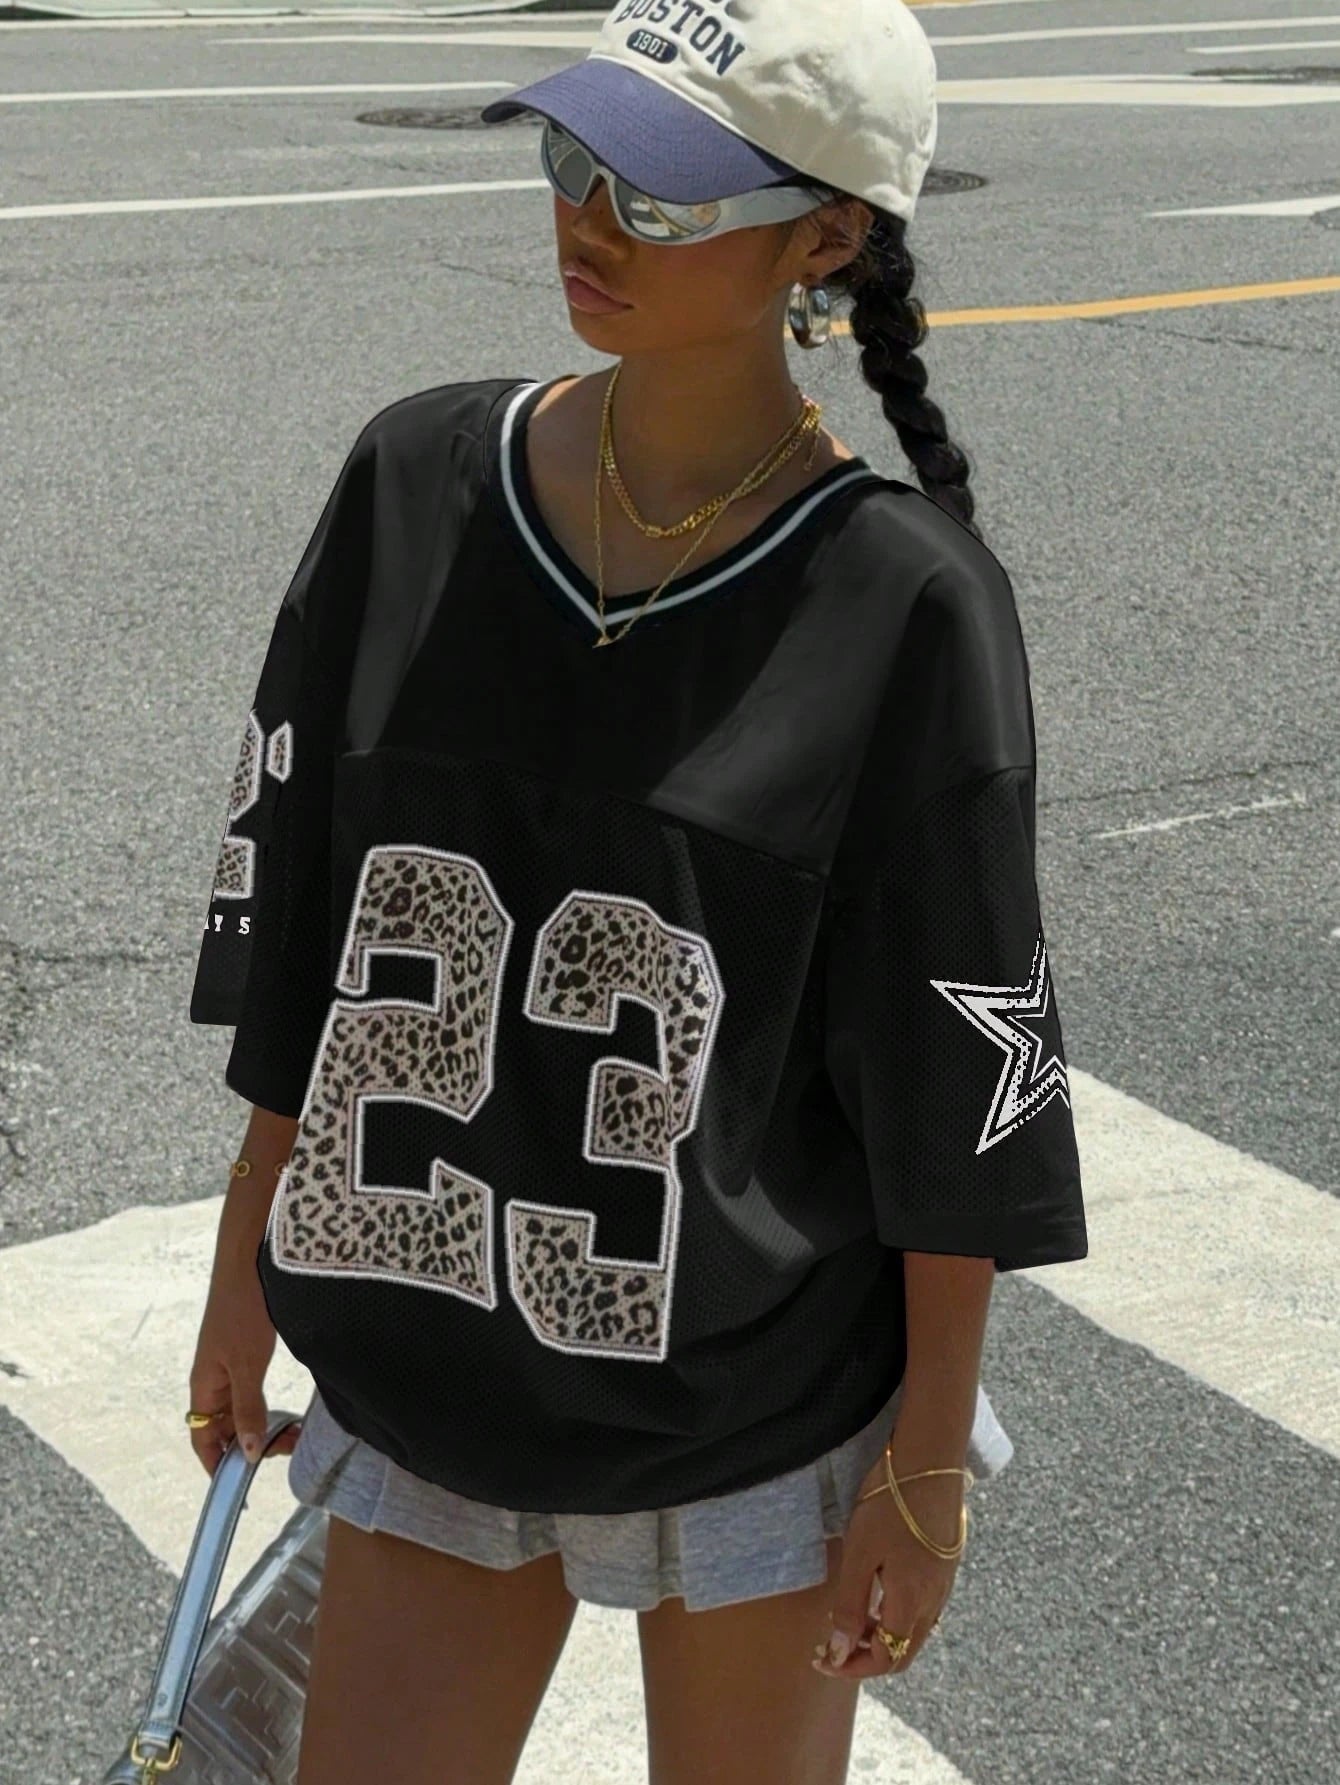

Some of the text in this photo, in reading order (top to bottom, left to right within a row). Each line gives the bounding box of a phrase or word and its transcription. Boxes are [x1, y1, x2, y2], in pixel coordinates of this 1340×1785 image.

[613, 0, 746, 76] BOSTON
[632, 31, 668, 58] 1901
[273, 844, 725, 1363] 23
